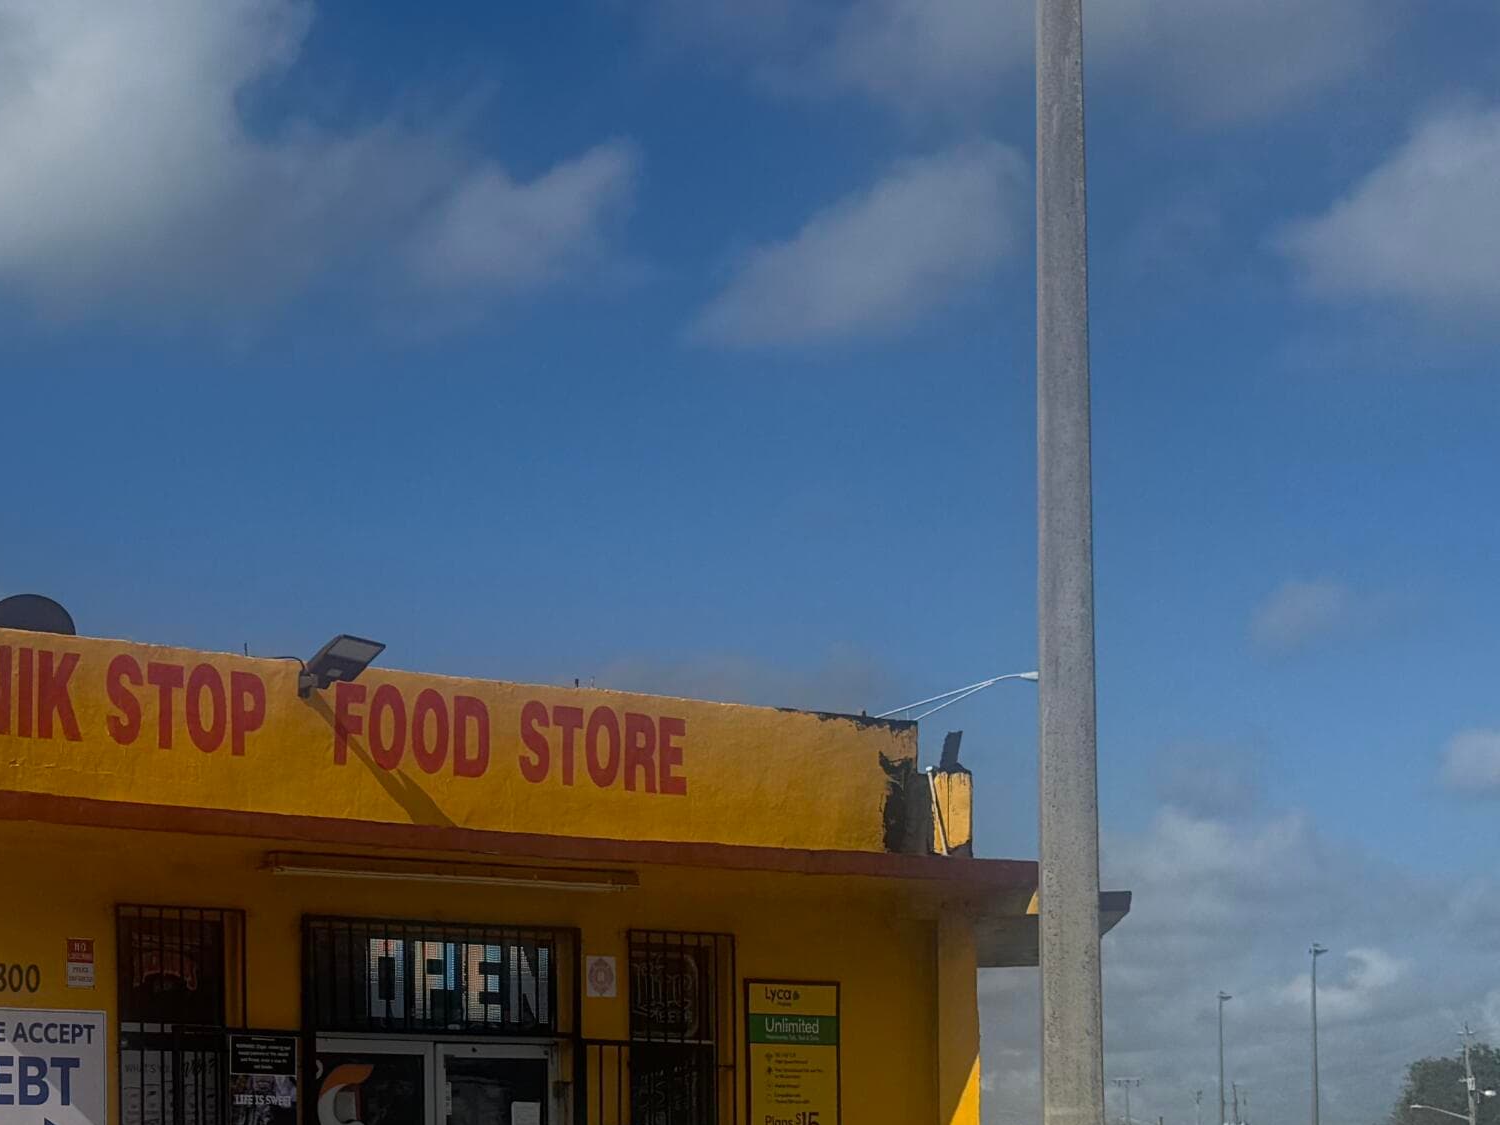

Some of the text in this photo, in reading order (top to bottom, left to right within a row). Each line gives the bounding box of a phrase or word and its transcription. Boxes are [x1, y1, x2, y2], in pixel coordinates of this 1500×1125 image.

[106, 653, 267, 757] STOP
[334, 681, 491, 779] FOOD
[518, 699, 687, 797] STORE
[366, 938, 549, 1024] OPEN
[764, 986, 792, 1003] Lyca
[12, 1022, 95, 1045] ACCEPT
[764, 1016, 820, 1034] Unlimited
[233, 1094, 292, 1108] LIFE IS SWEET
